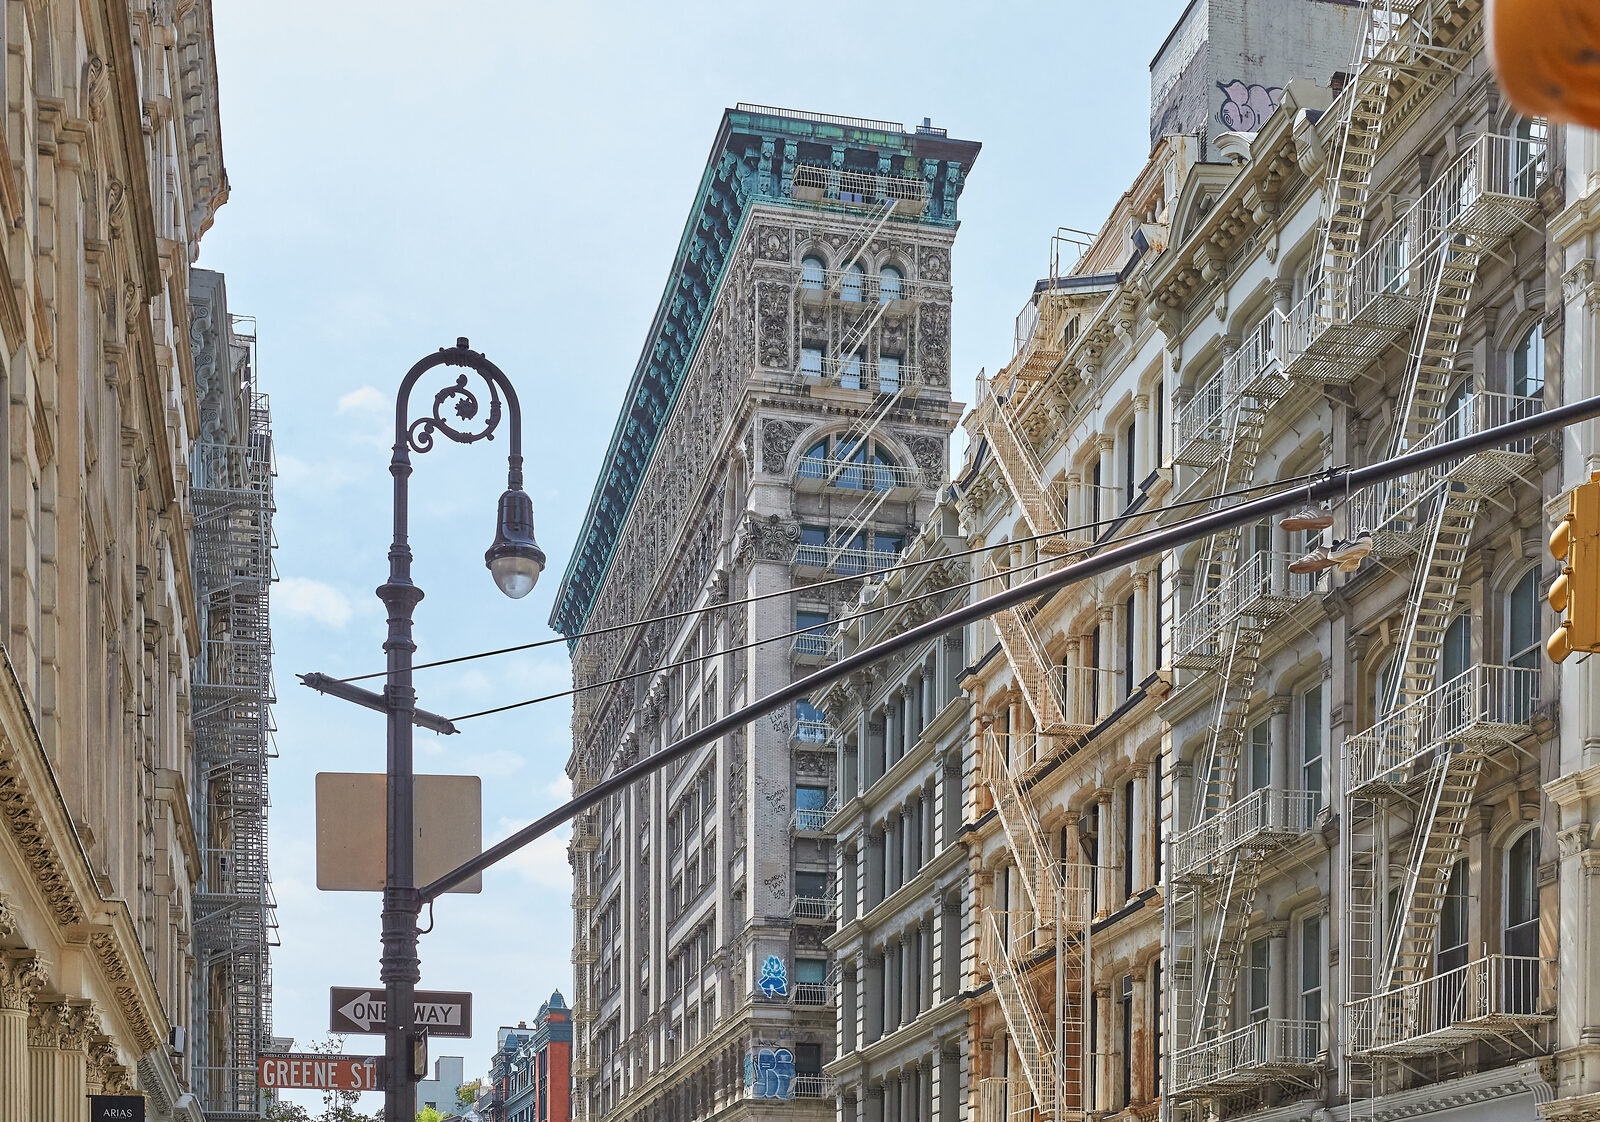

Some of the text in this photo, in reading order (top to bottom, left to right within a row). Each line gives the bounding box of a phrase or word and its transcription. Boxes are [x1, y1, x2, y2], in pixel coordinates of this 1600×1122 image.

[414, 1005, 453, 1023] WAY
[263, 1060, 374, 1089] GREENE ST
[103, 1108, 133, 1118] ARIAS
